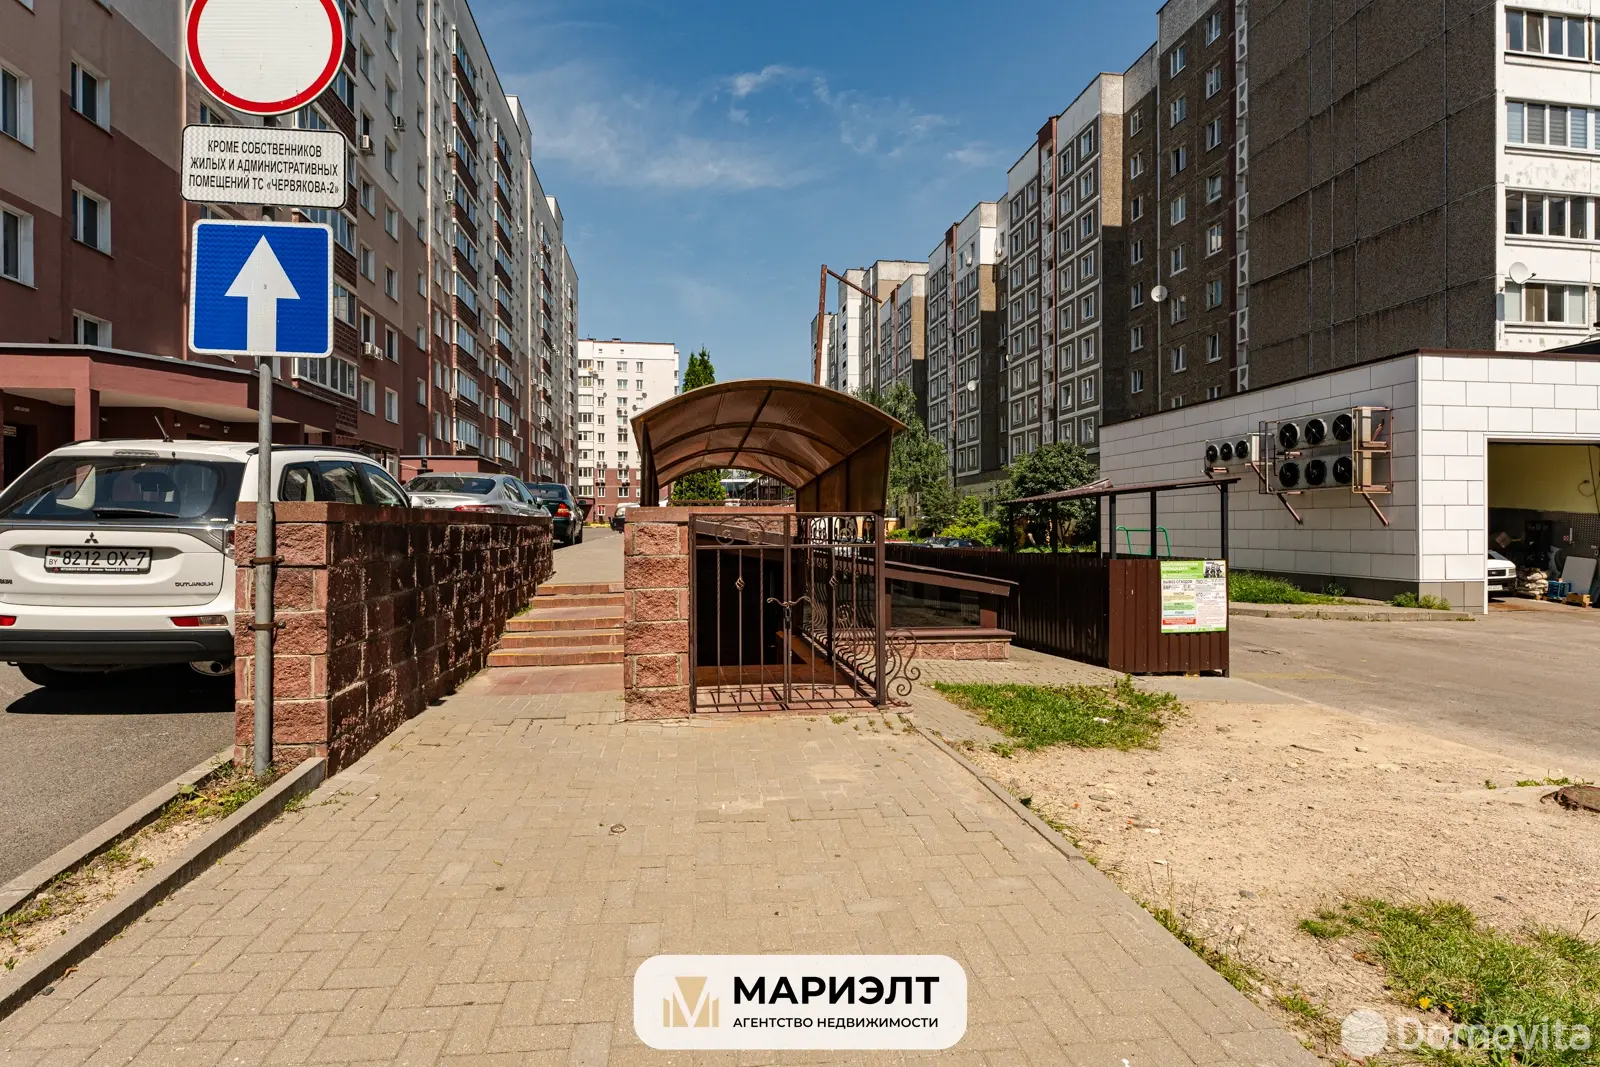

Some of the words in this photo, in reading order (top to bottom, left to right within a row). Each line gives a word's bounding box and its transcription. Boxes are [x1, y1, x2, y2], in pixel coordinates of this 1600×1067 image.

[208, 140, 239, 153] КРОМЕ
[241, 142, 322, 158] СОБСТВЕННИКОВ
[190, 157, 226, 171] ЖИЛЫХ
[228, 159, 235, 171] И
[237, 160, 338, 176] АДМИНИСТРАТИВНЫХ
[188, 174, 250, 190] ПОМЕЩЕНИЙ
[252, 178, 264, 190] ТС
[266, 179, 339, 194] «ЧЕРВЯКОВА-2»
[62, 550, 101, 566] 8212
[107, 551, 147, 566] OX-7
